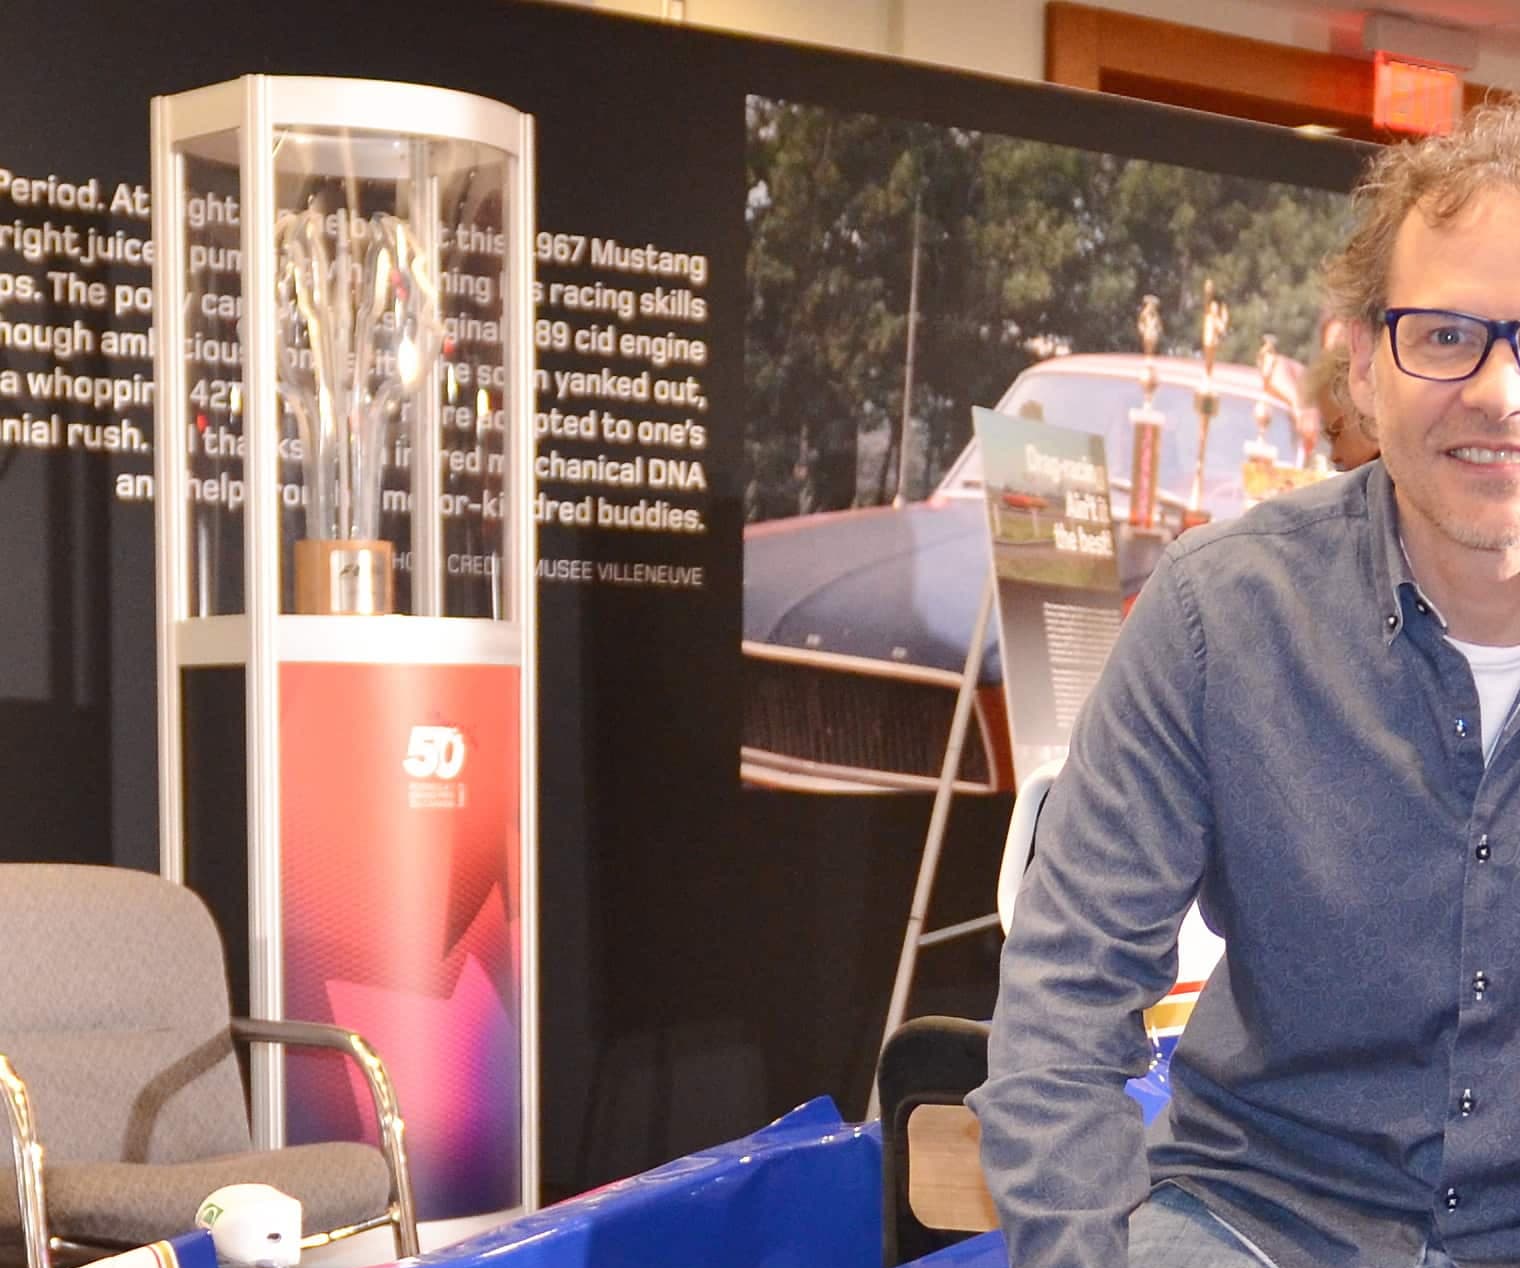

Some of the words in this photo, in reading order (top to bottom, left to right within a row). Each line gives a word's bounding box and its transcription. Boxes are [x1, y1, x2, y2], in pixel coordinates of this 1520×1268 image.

[110, 183, 149, 215] At
[532, 231, 586, 262] 967
[591, 237, 706, 284] Mustang
[47, 271, 107, 306] The
[534, 318, 569, 350] 89
[574, 323, 616, 354] cid
[619, 331, 707, 366] engine
[549, 281, 635, 319] racing
[639, 286, 707, 322] skills
[27, 366, 156, 411] whoppin
[602, 411, 634, 441] to
[637, 419, 707, 449] one's
[554, 367, 650, 400] yanked
[654, 376, 707, 410] out,
[67, 418, 149, 452] rush.
[648, 457, 706, 490] DNA
[597, 497, 706, 532] buddies.
[597, 561, 704, 586] VILLENEUVE
[402, 725, 466, 780] 50
